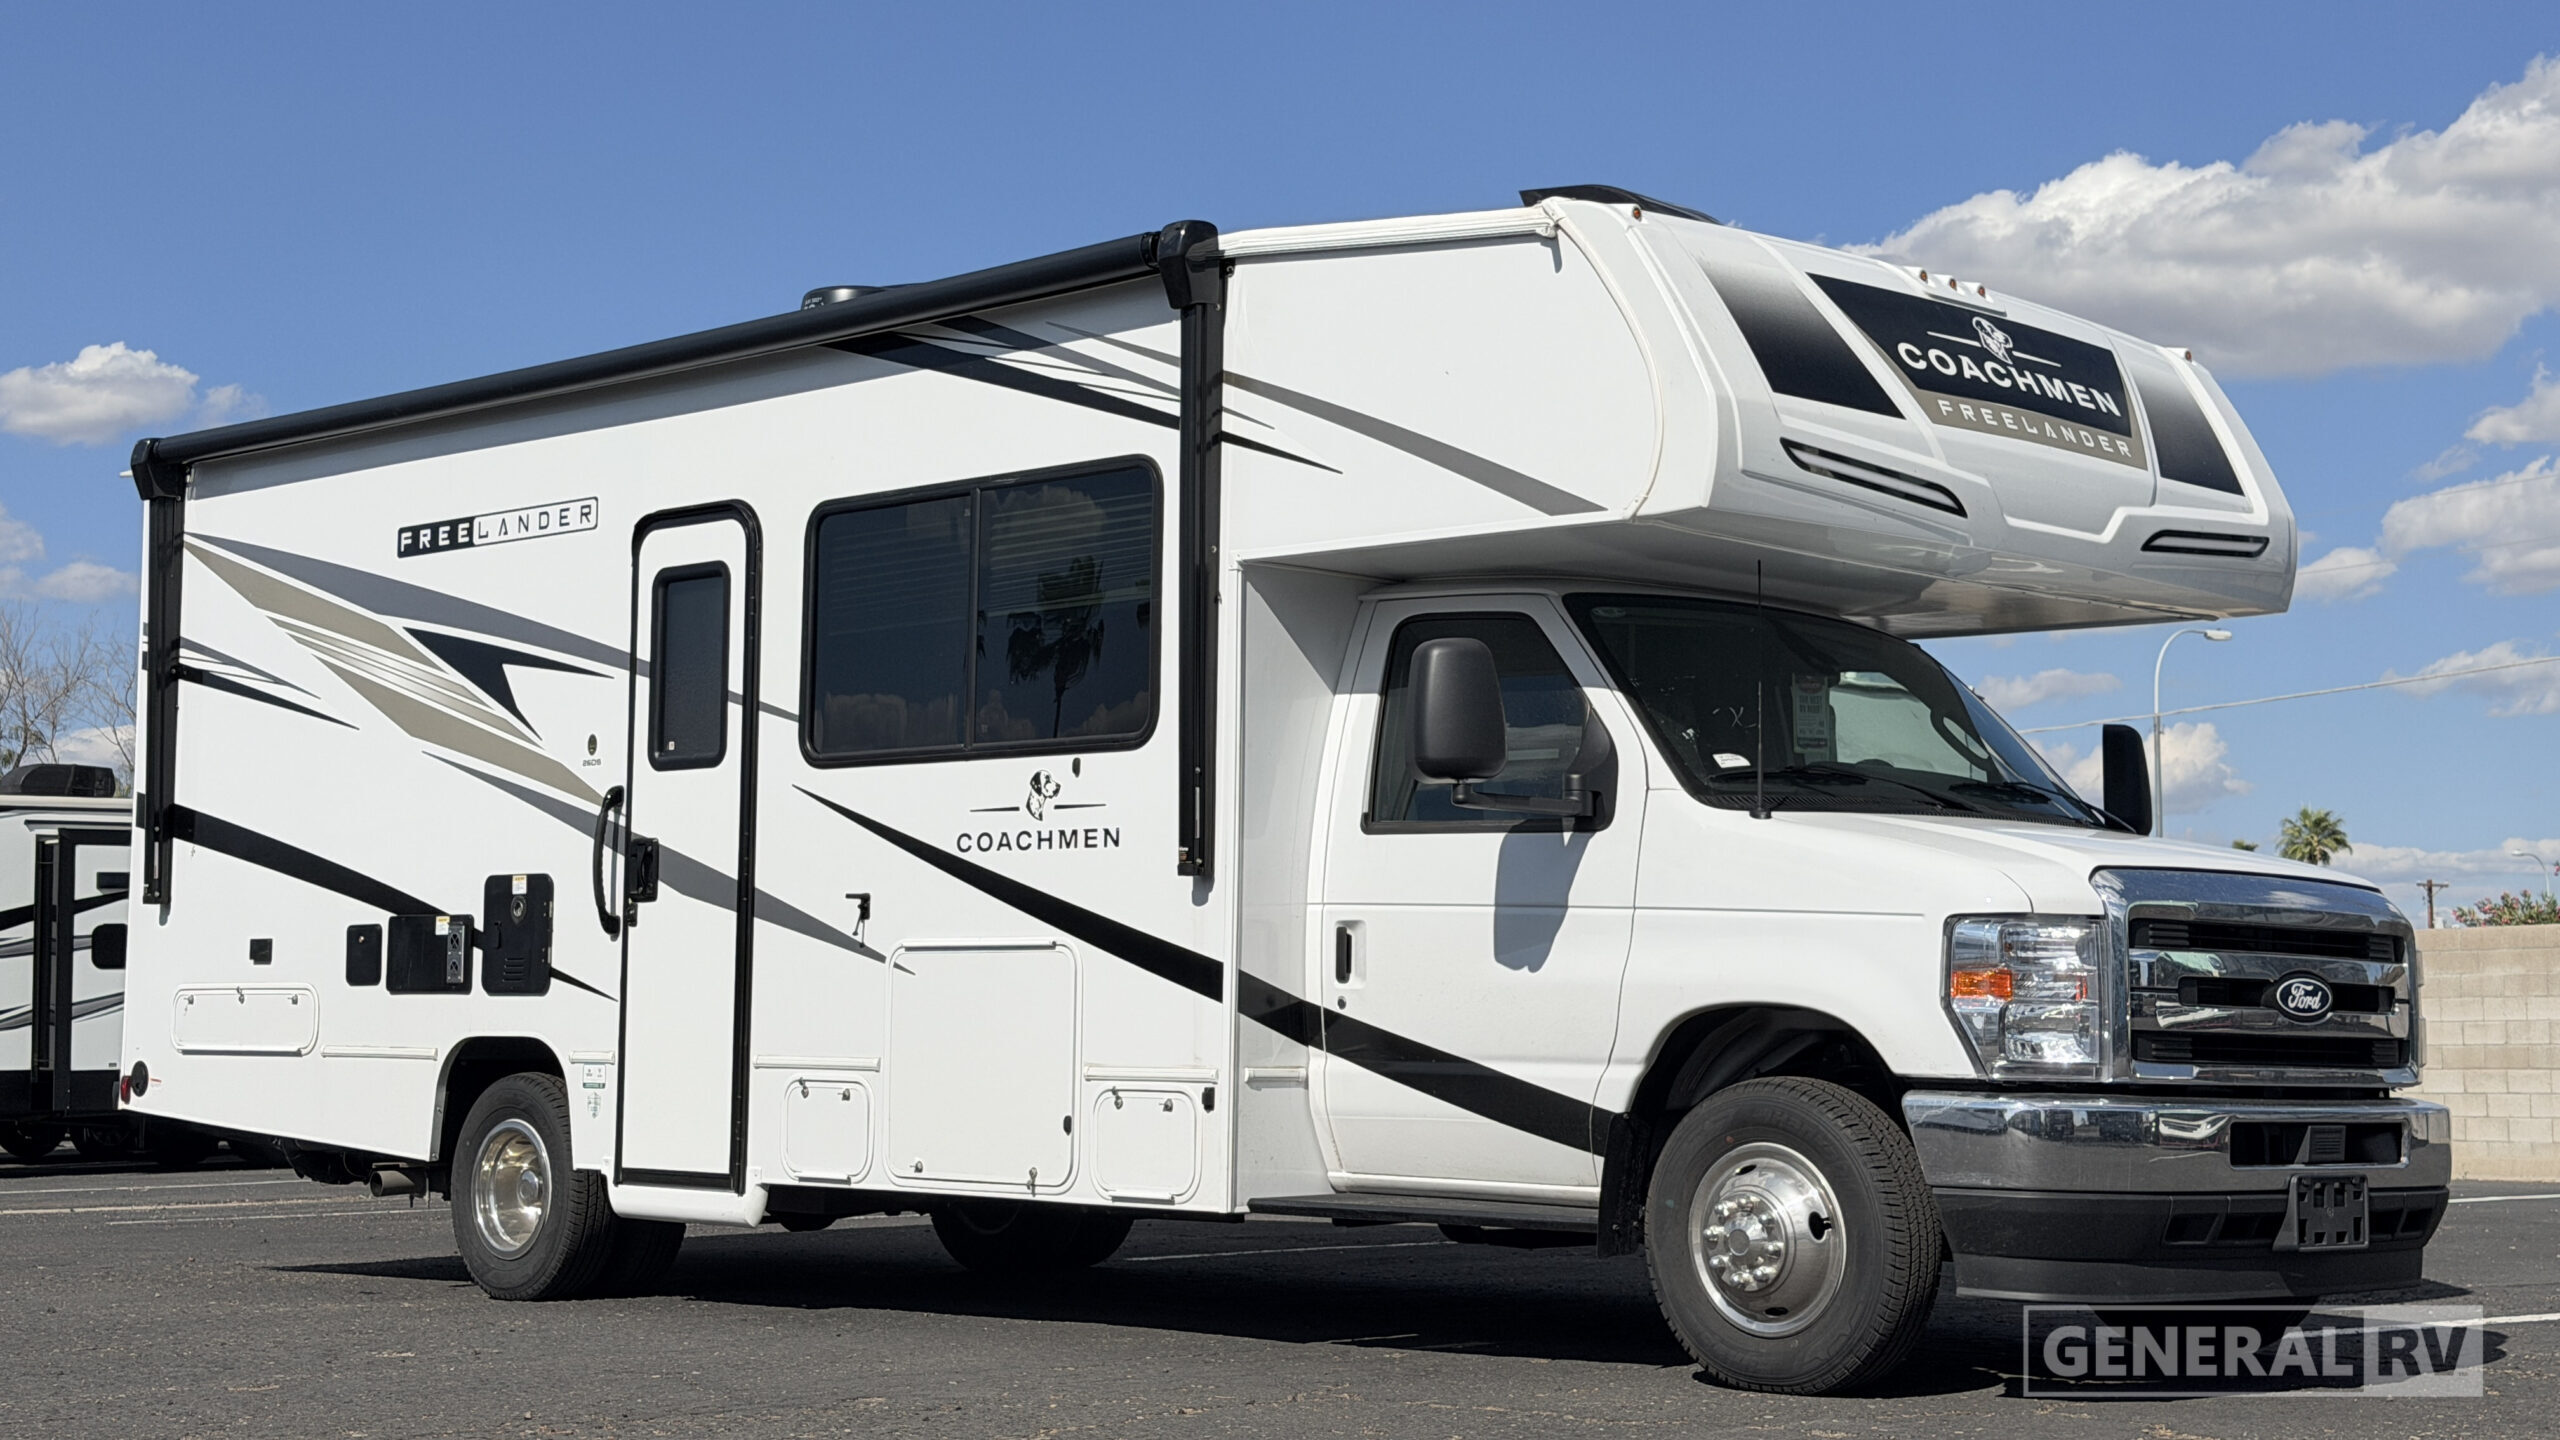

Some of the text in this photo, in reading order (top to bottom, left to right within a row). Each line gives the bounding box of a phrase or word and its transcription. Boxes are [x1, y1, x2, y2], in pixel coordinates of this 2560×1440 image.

[1897, 341, 2122, 418] COACHMEN
[1938, 399, 2133, 459] FREELANDER
[400, 504, 593, 553] FREELANDER
[956, 827, 1121, 853] COACHMEN
[2287, 982, 2322, 1010] Ford
